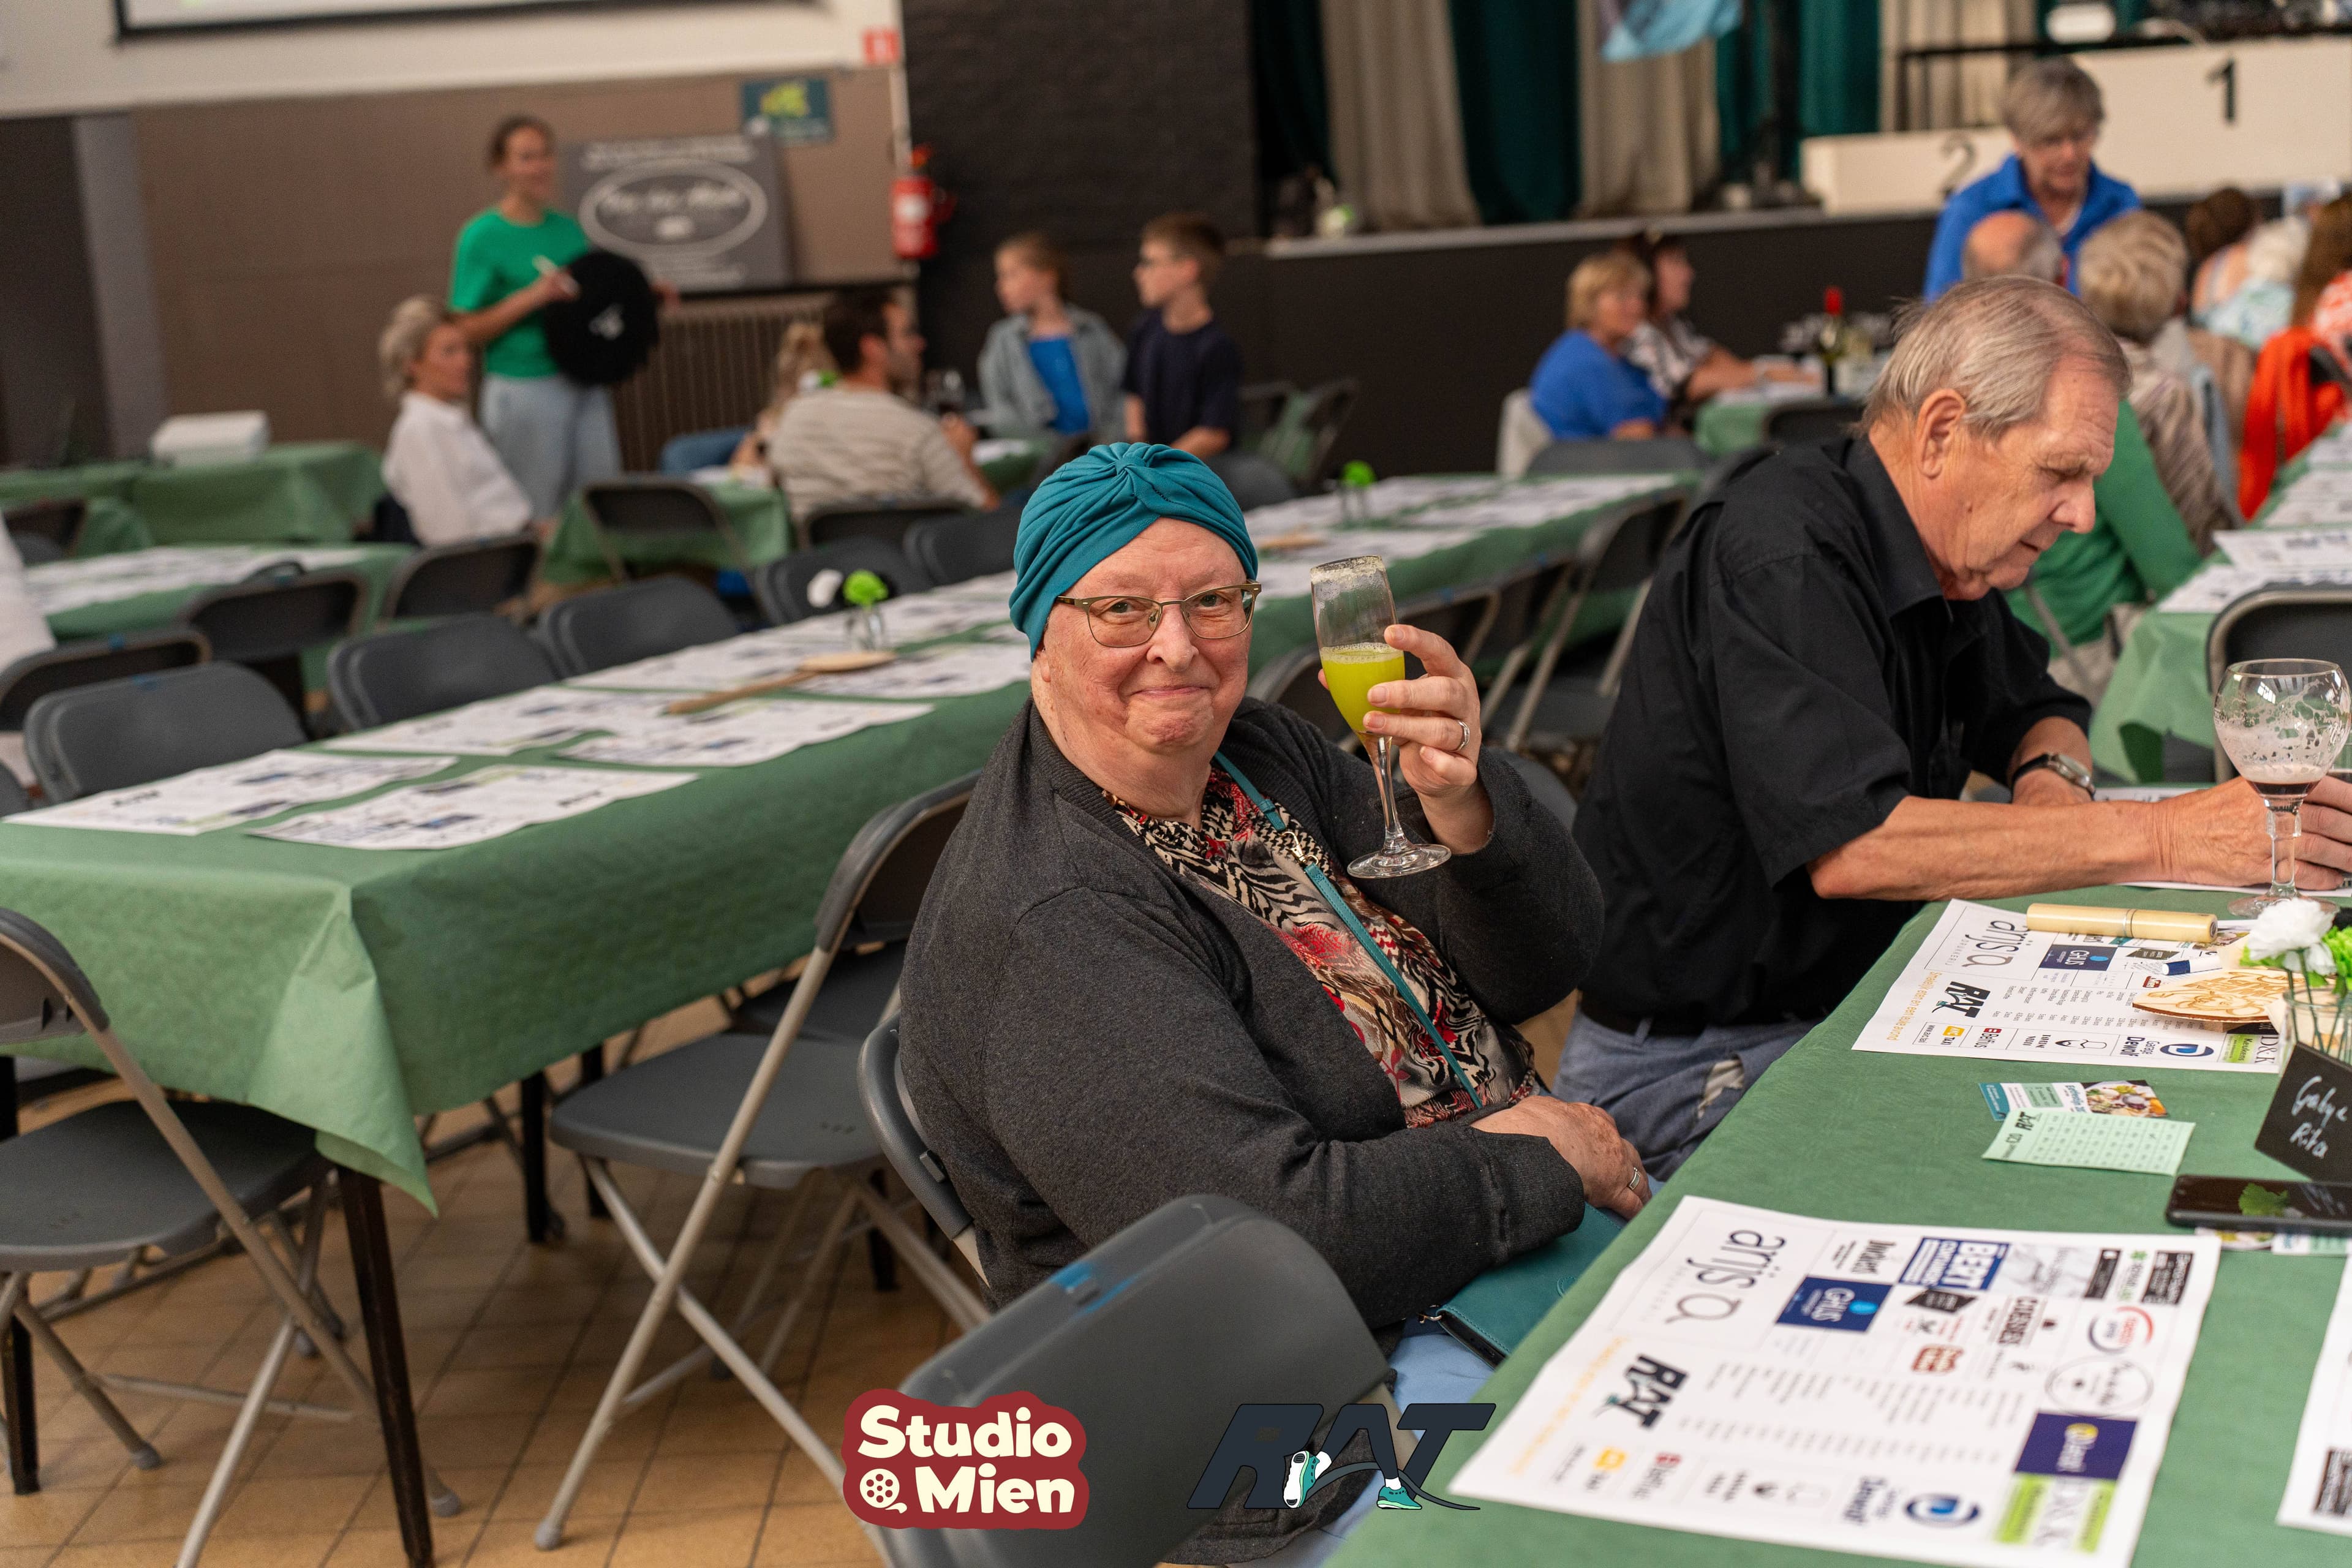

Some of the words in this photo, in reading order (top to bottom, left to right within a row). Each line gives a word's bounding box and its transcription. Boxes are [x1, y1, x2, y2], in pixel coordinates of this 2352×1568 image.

[2206, 57, 2237, 125] 1
[1918, 971, 1942, 990] Smakelijk
[1913, 989, 1928, 1000] eten
[1931, 981, 1991, 1018] RAT
[1905, 1006, 1917, 1016] een
[1940, 1036, 1955, 1046] TAXI
[1974, 1033, 2000, 1048] Belfius
[2120, 1036, 2146, 1057] Dewolf
[2142, 1041, 2160, 1055] Garage
[2238, 1038, 2253, 1061] Keukens
[1941, 1243, 1999, 1290] BERT
[1593, 1354, 1689, 1429] RAT
